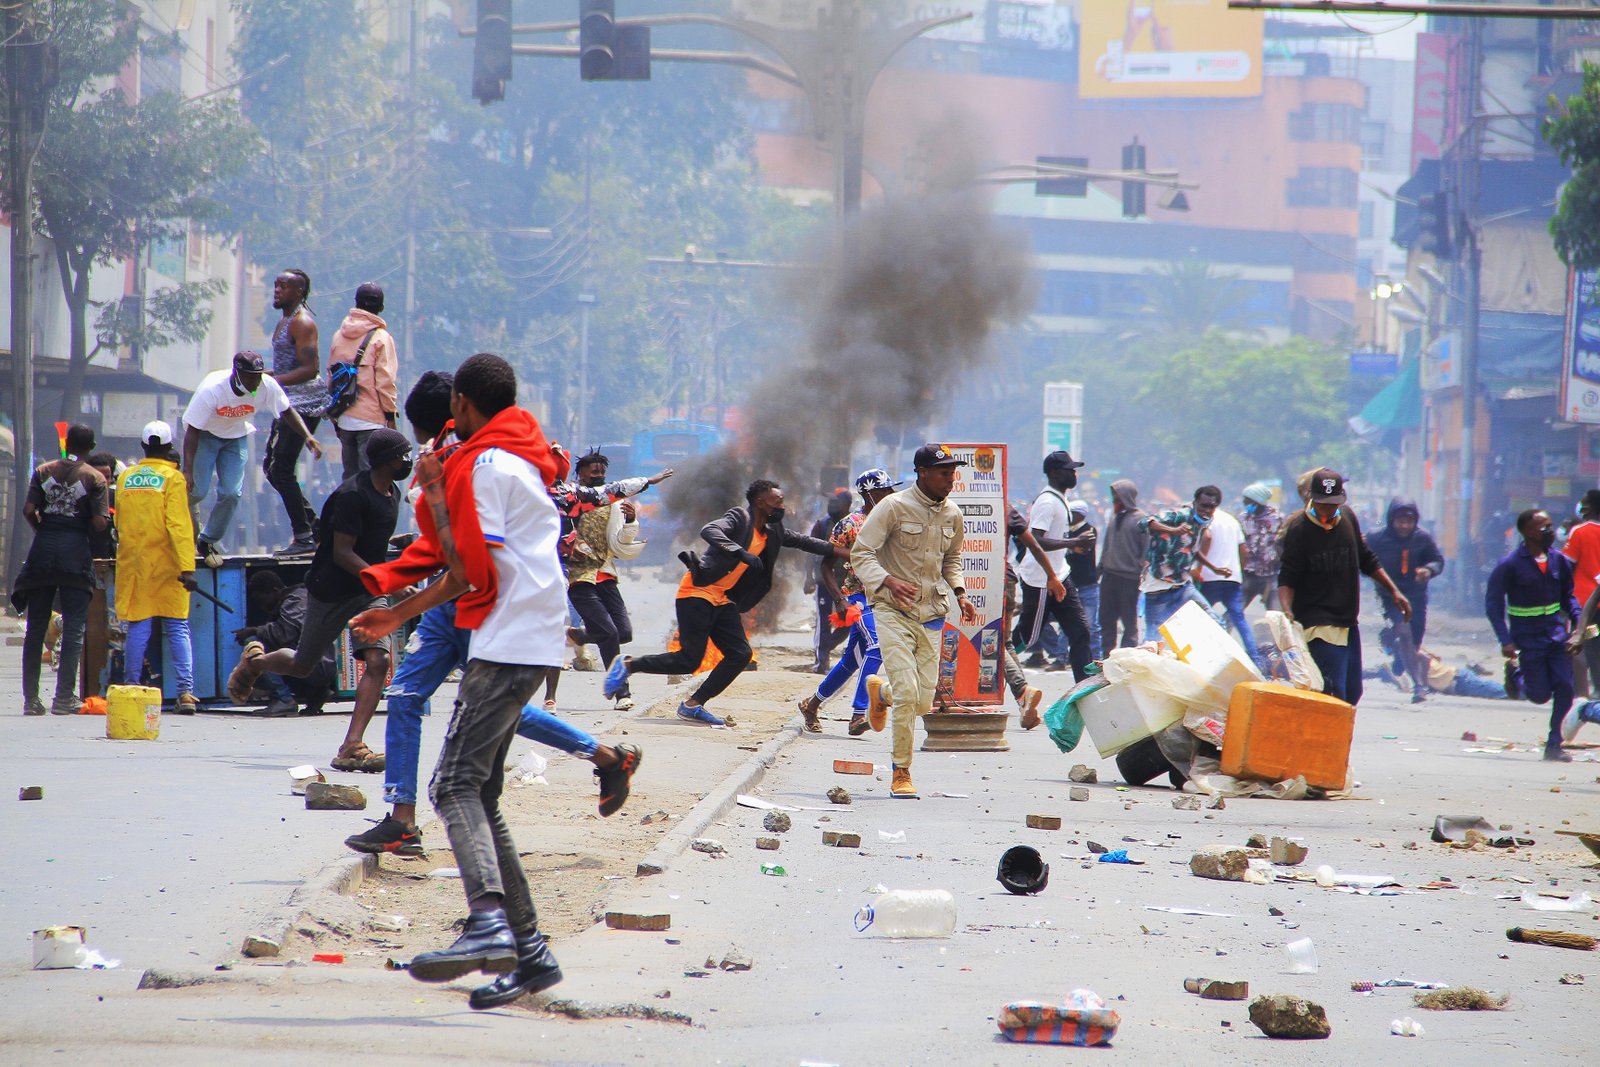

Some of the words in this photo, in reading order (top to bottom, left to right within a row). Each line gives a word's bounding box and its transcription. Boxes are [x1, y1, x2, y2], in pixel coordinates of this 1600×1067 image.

[953, 453, 976, 468] OUTE
[126, 475, 161, 487] SOKO
[973, 471, 996, 480] DIGITAL
[969, 483, 990, 493] LUXURY
[991, 483, 1001, 493] LTD
[965, 505, 979, 515] Route
[980, 505, 991, 515] Alert
[963, 521, 998, 534] STLANDS
[961, 539, 992, 552] ANGEMI
